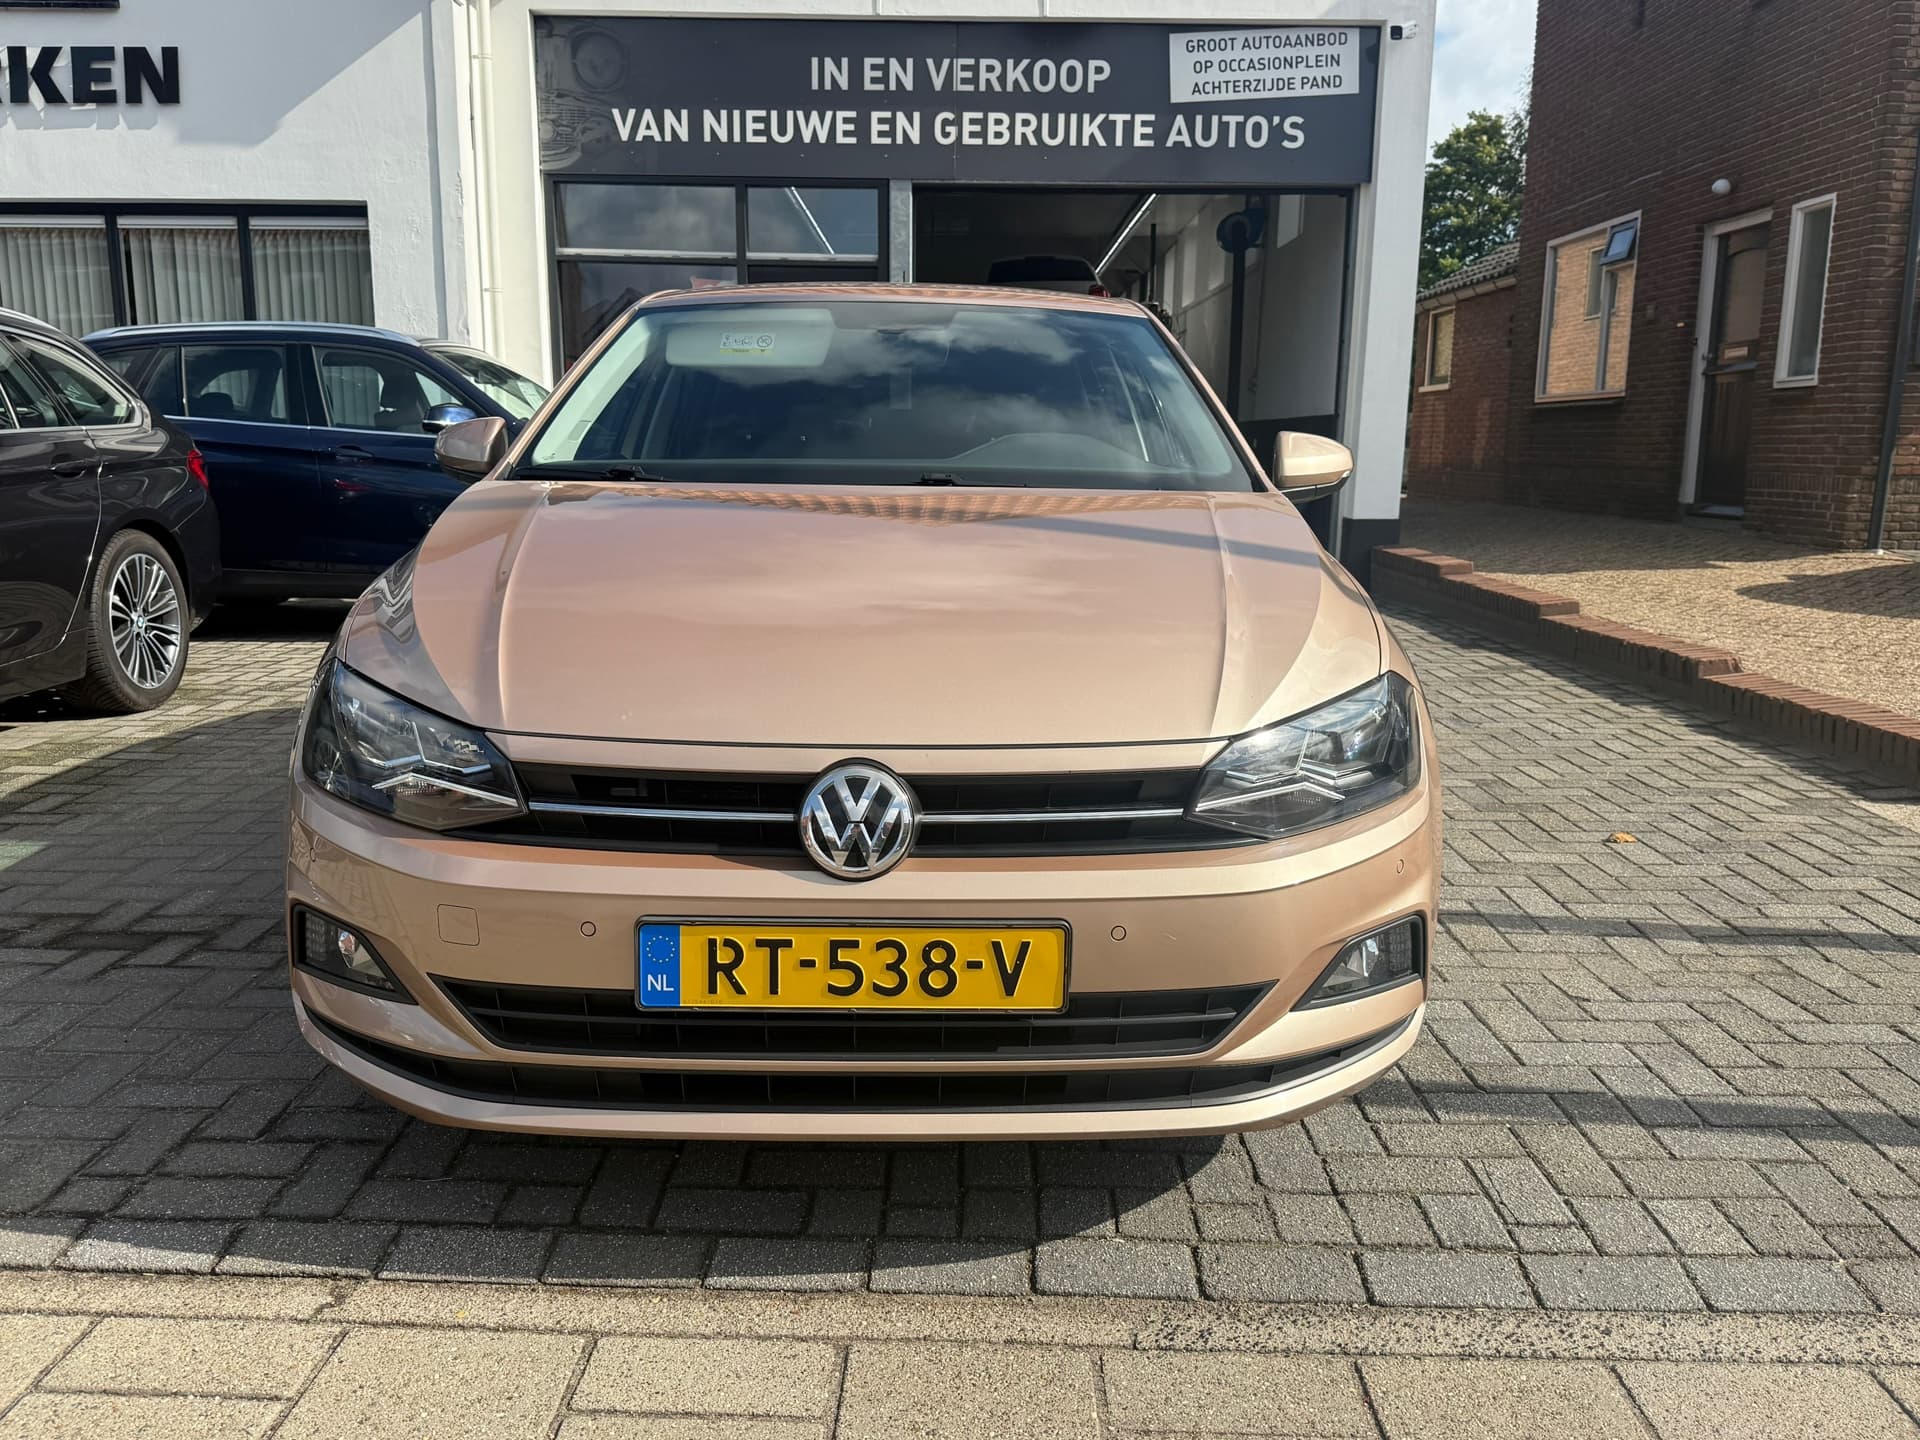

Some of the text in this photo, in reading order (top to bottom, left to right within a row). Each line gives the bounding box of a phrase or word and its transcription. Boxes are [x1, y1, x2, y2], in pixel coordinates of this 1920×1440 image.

[1185, 32, 1348, 53] GROOT AUTOAANBOD
[0, 46, 181, 104] KEN
[811, 57, 1111, 93] IN EN VERKOOP
[1193, 53, 1341, 74] OP OCCASIONPLEIN
[1191, 74, 1343, 95] ACHTERZIJDE PAND
[611, 108, 1305, 149] VAN NIEUWE EN GEBRUIKTE AUTO'S
[647, 937, 1032, 998] NL RT-538-V
